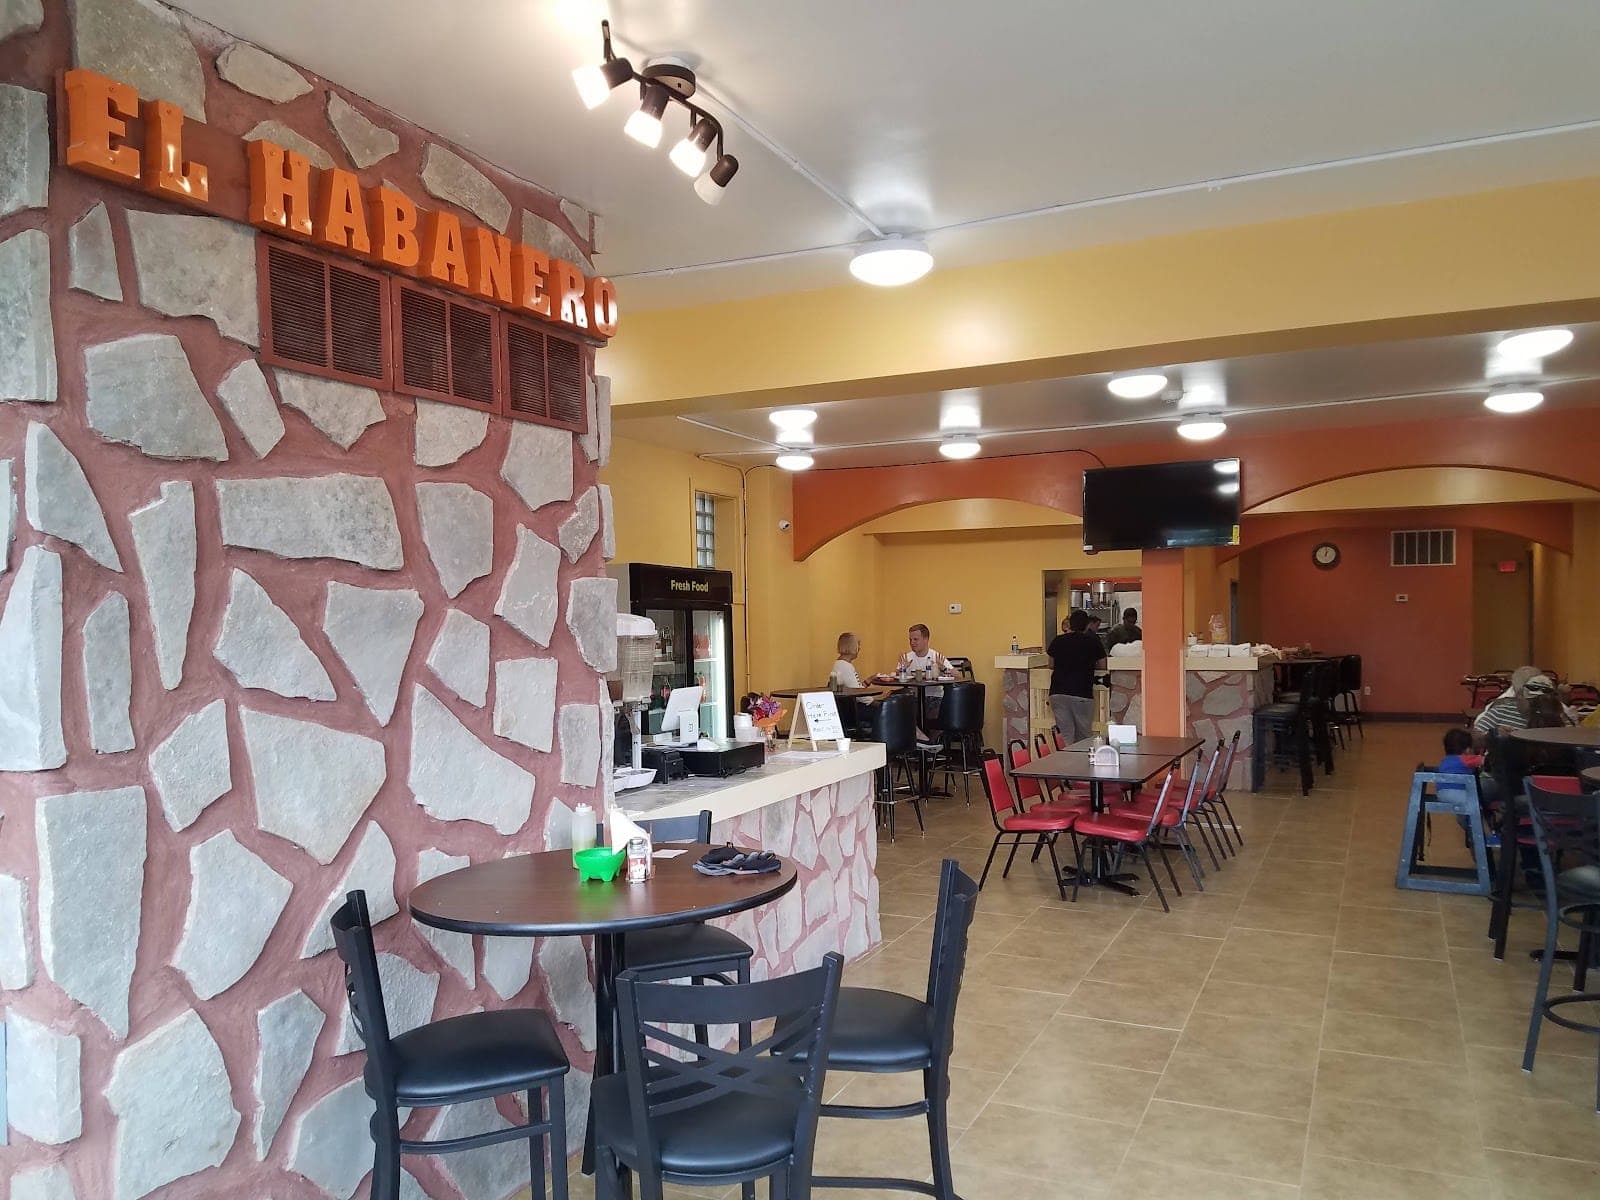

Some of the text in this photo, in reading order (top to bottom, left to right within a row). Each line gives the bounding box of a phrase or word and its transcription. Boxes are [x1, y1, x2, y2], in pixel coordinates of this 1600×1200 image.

[65, 69, 618, 341] EL HABANERO
[670, 579, 709, 592] Fresh Food
